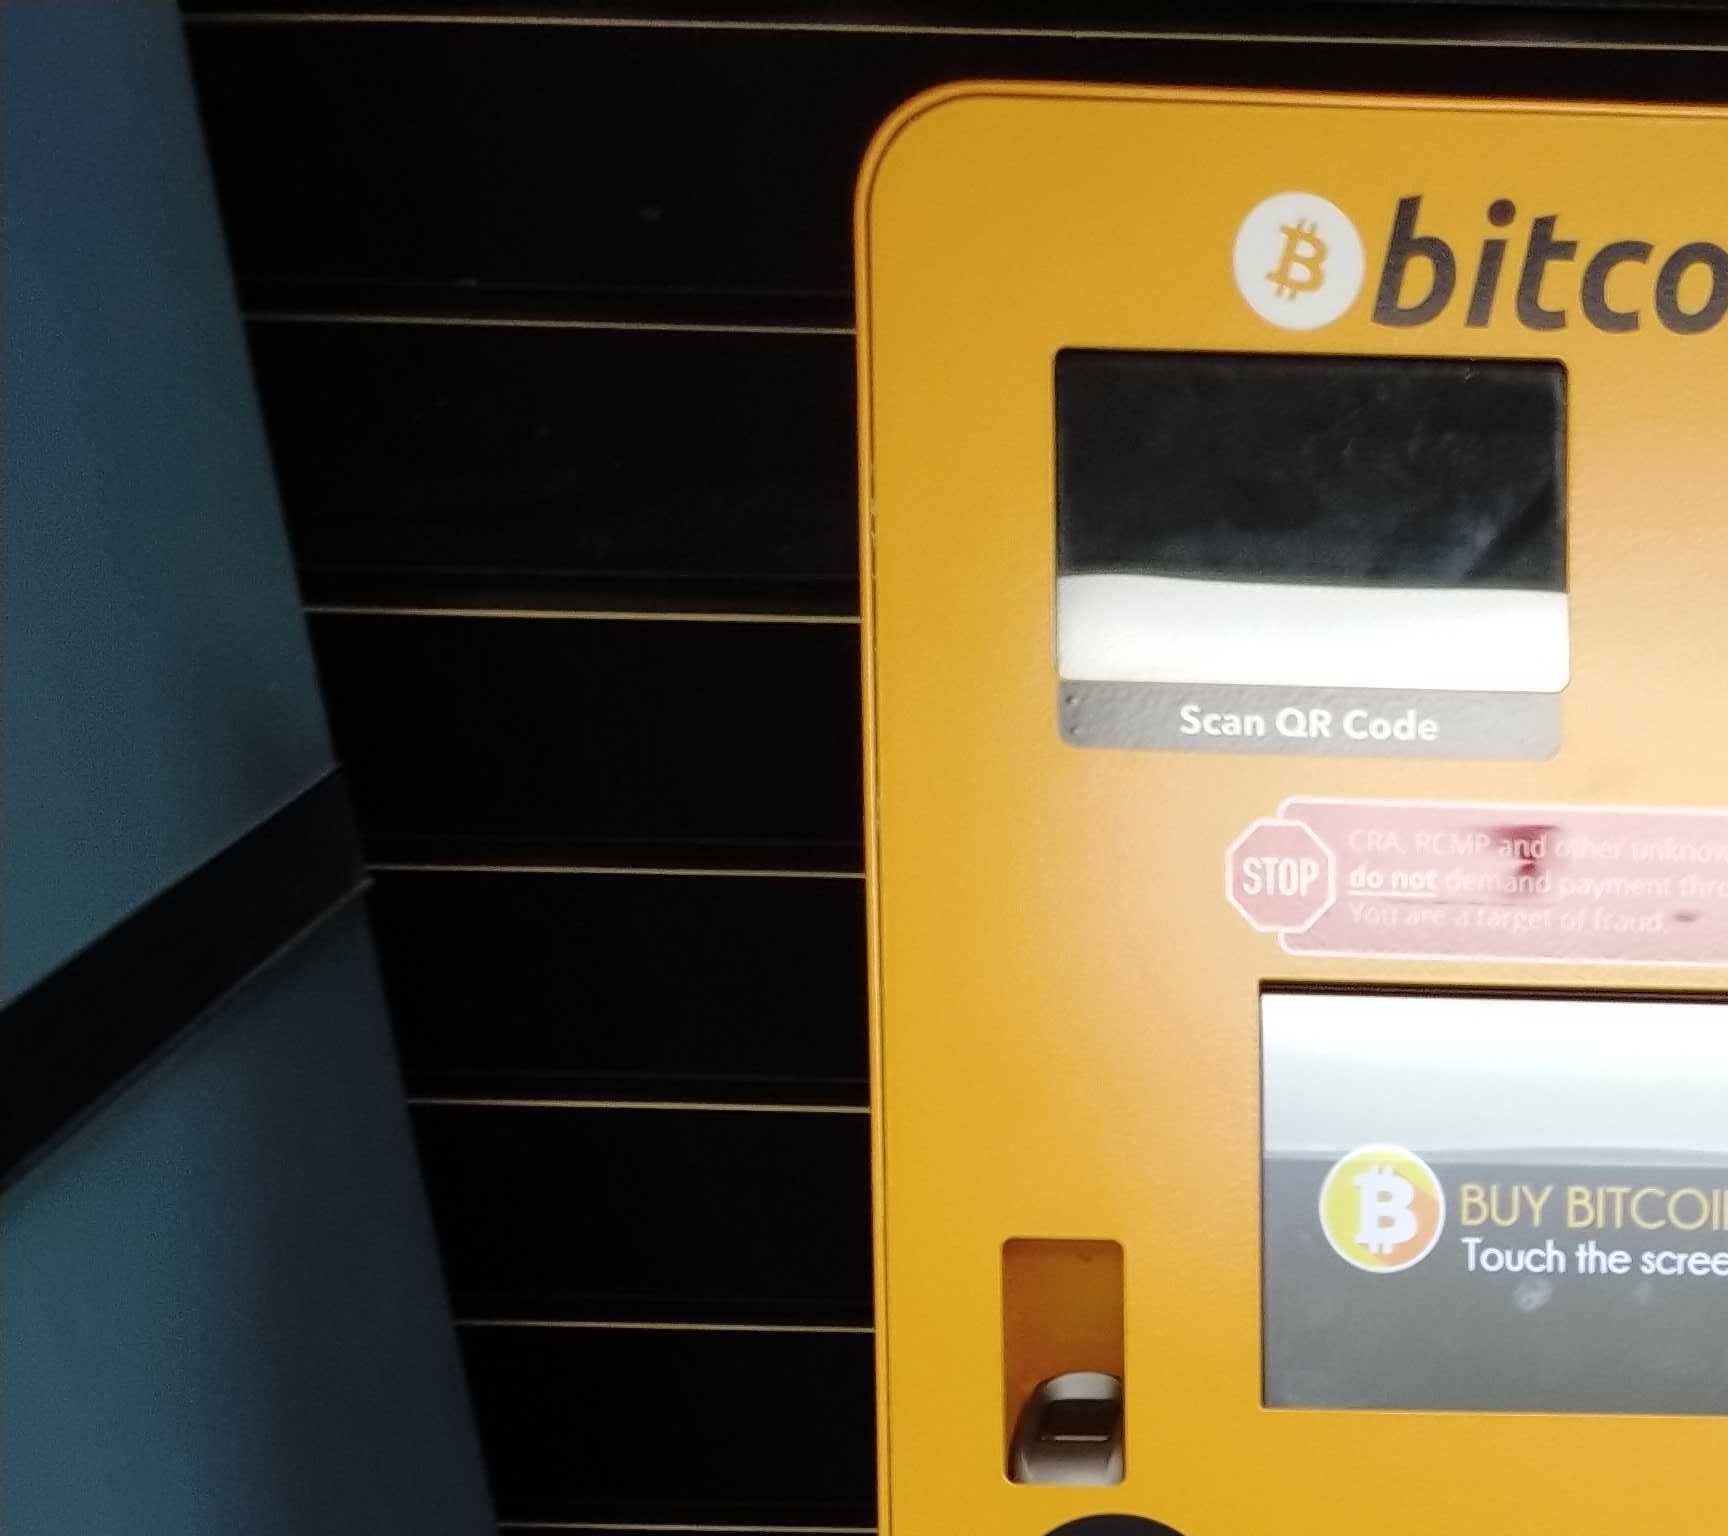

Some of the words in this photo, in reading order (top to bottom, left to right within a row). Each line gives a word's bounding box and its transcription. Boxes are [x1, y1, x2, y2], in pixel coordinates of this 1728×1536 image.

[1180, 705, 1263, 736] Scan
[1276, 709, 1331, 740] QR
[1343, 711, 1438, 741] Code
[1415, 833, 1490, 856] RCMP
[1499, 833, 1546, 858] and
[1554, 834, 1625, 860] other
[1241, 857, 1318, 896] STOP
[1351, 864, 1383, 889] do
[1392, 866, 1438, 891] not
[1445, 868, 1550, 894] demand
[1559, 874, 1670, 900] payment
[1461, 1184, 1552, 1228] BUY
[1461, 1238, 1566, 1275] Touch
[1576, 1241, 1631, 1275] the
